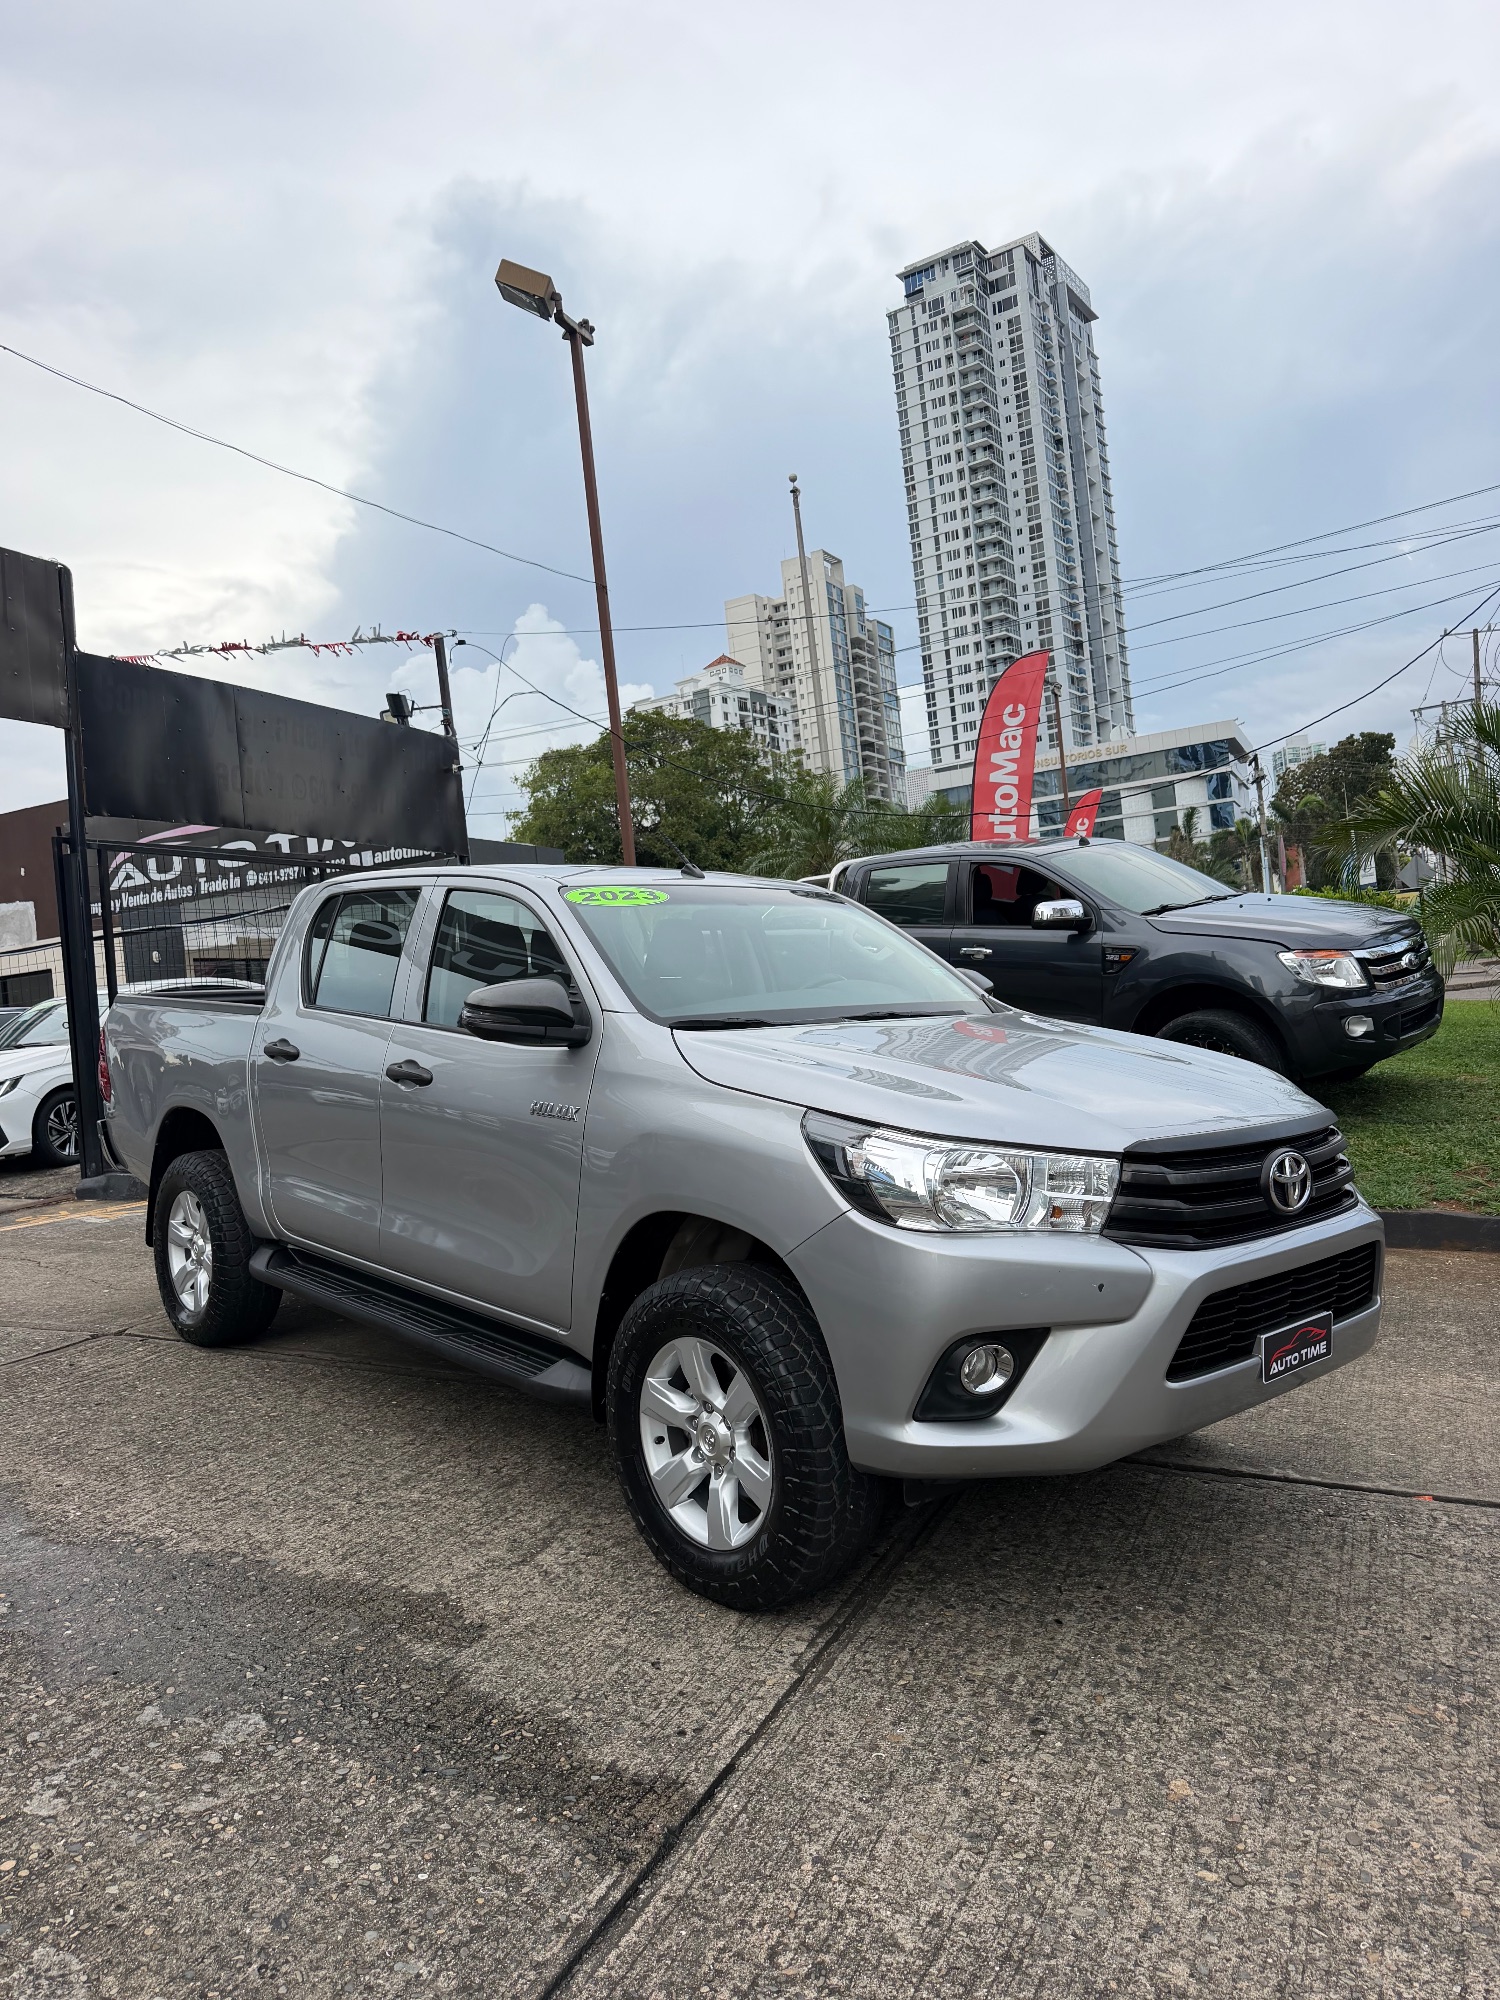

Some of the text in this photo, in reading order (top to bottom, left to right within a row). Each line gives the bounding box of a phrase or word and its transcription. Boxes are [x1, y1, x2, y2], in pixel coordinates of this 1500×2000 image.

[1034, 744, 1128, 769] NSUTORIOS SUR
[988, 703, 1025, 840] utoMac
[121, 891, 150, 908] Venta
[150, 886, 163, 903] de
[164, 884, 193, 901] Autos
[198, 874, 229, 895] Trade
[578, 890, 661, 902] 2023
[529, 1099, 581, 1122] HILUX
[1270, 1341, 1327, 1375] AUTO TIME
